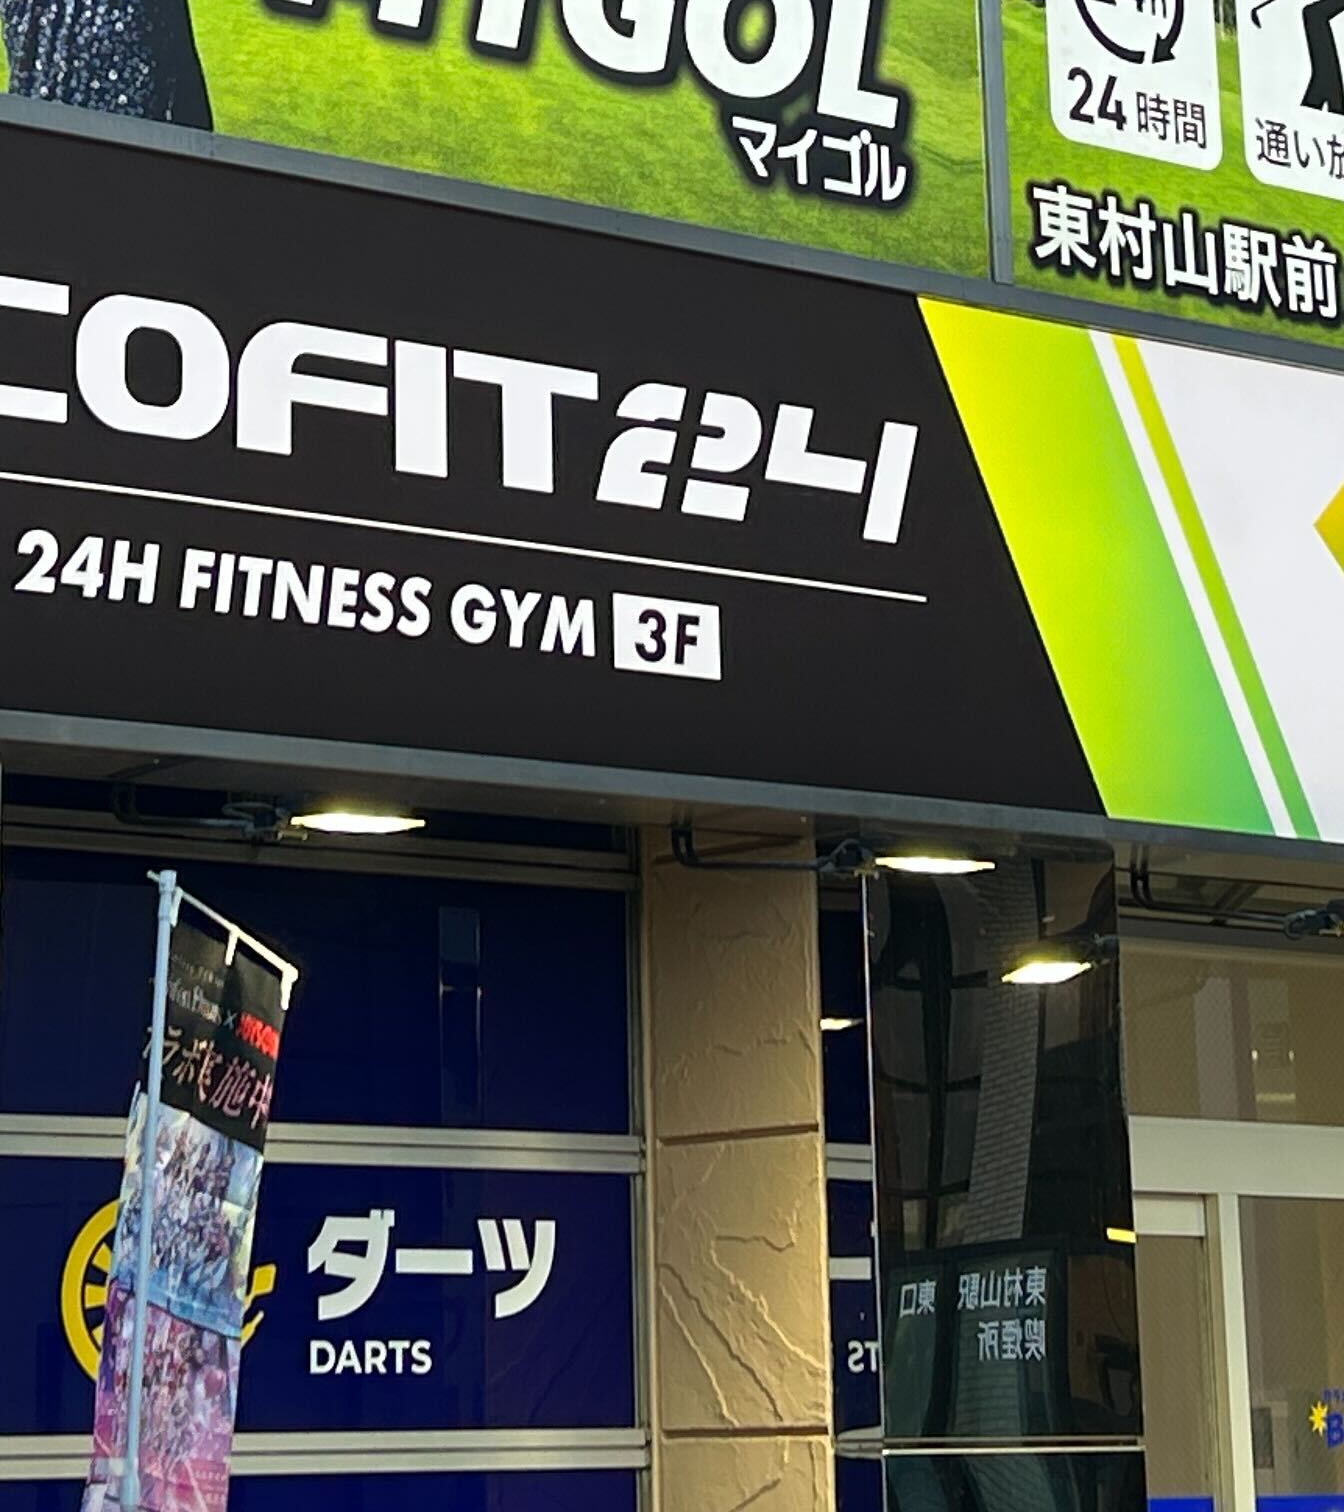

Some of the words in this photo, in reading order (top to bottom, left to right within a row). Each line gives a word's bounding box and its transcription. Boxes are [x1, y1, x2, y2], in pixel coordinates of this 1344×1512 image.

[731, 115, 907, 202] マイゴル
[14, 528, 160, 605] 24H
[179, 548, 433, 638] FITNESS
[450, 582, 596, 658] GYM
[634, 608, 701, 665] 3F
[307, 1208, 556, 1320] ダーツ
[309, 1339, 433, 1375] DARTS
